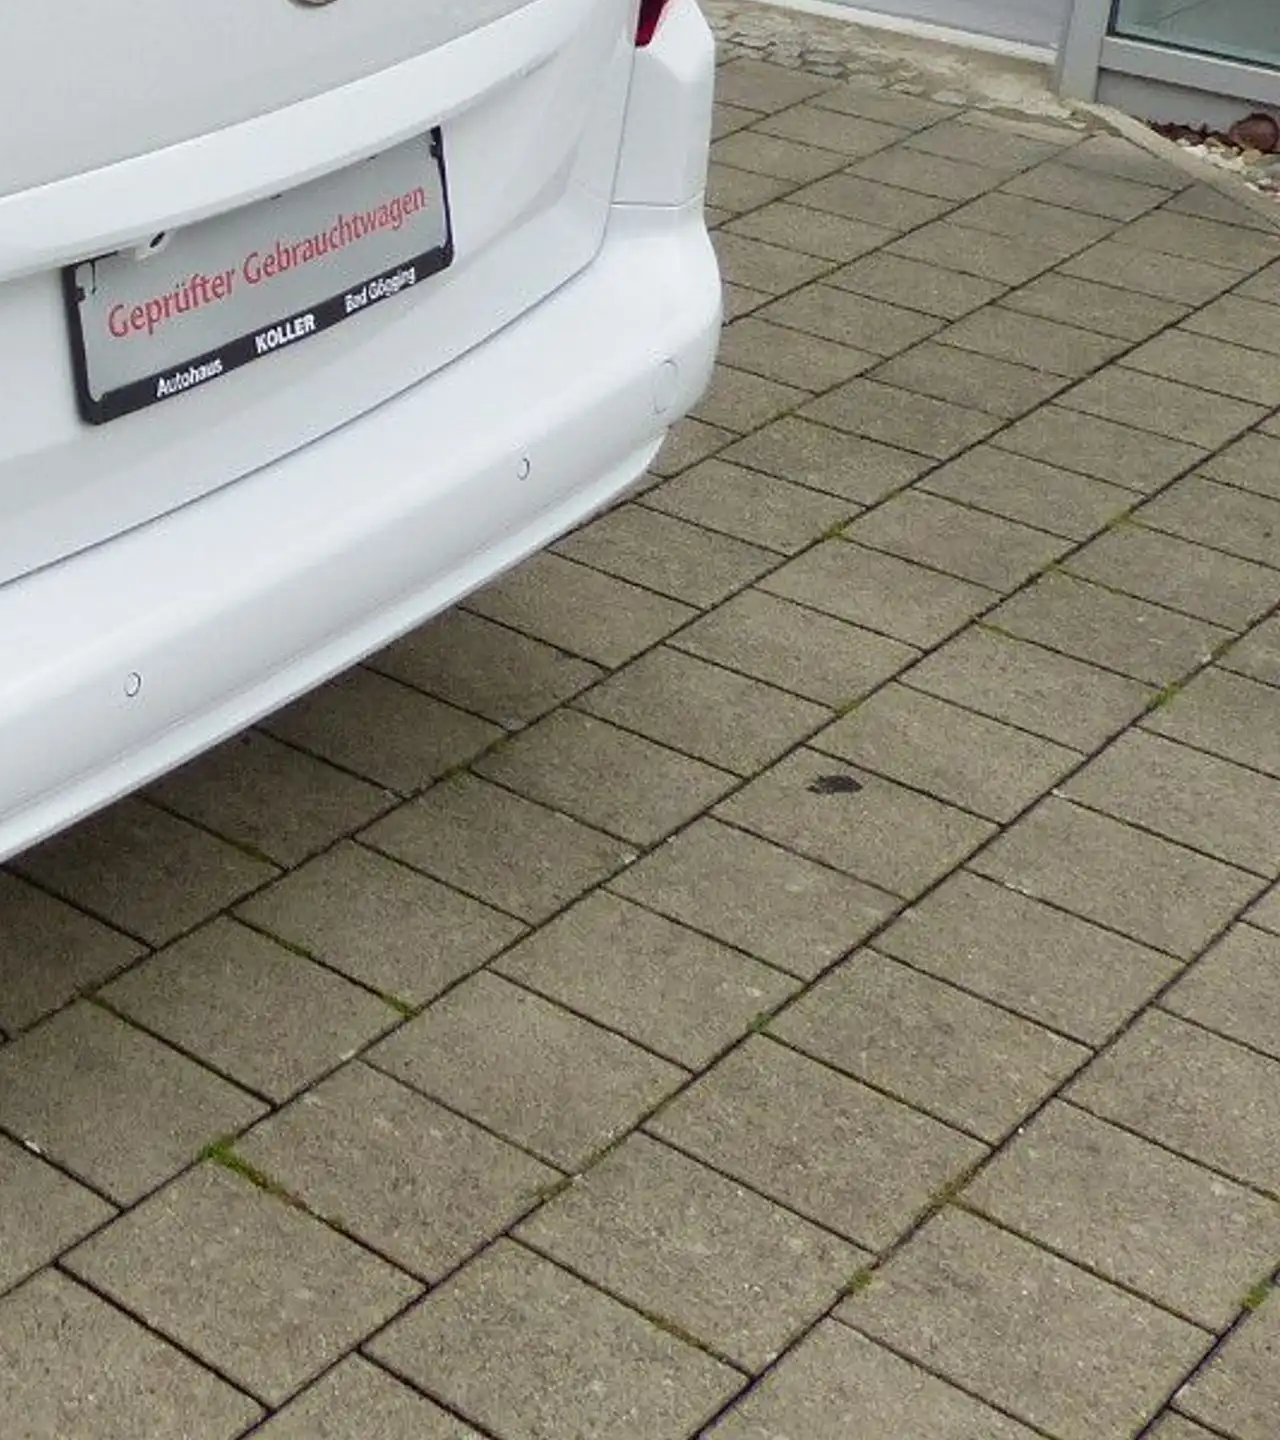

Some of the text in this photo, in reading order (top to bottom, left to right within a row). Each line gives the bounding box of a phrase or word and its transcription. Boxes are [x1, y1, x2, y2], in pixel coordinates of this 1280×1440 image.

[106, 185, 427, 338] Geprüfter Gebrauchtwagen
[156, 359, 223, 398] Autohaus
[254, 313, 316, 354] KOLLER
[344, 286, 368, 313] Bad
